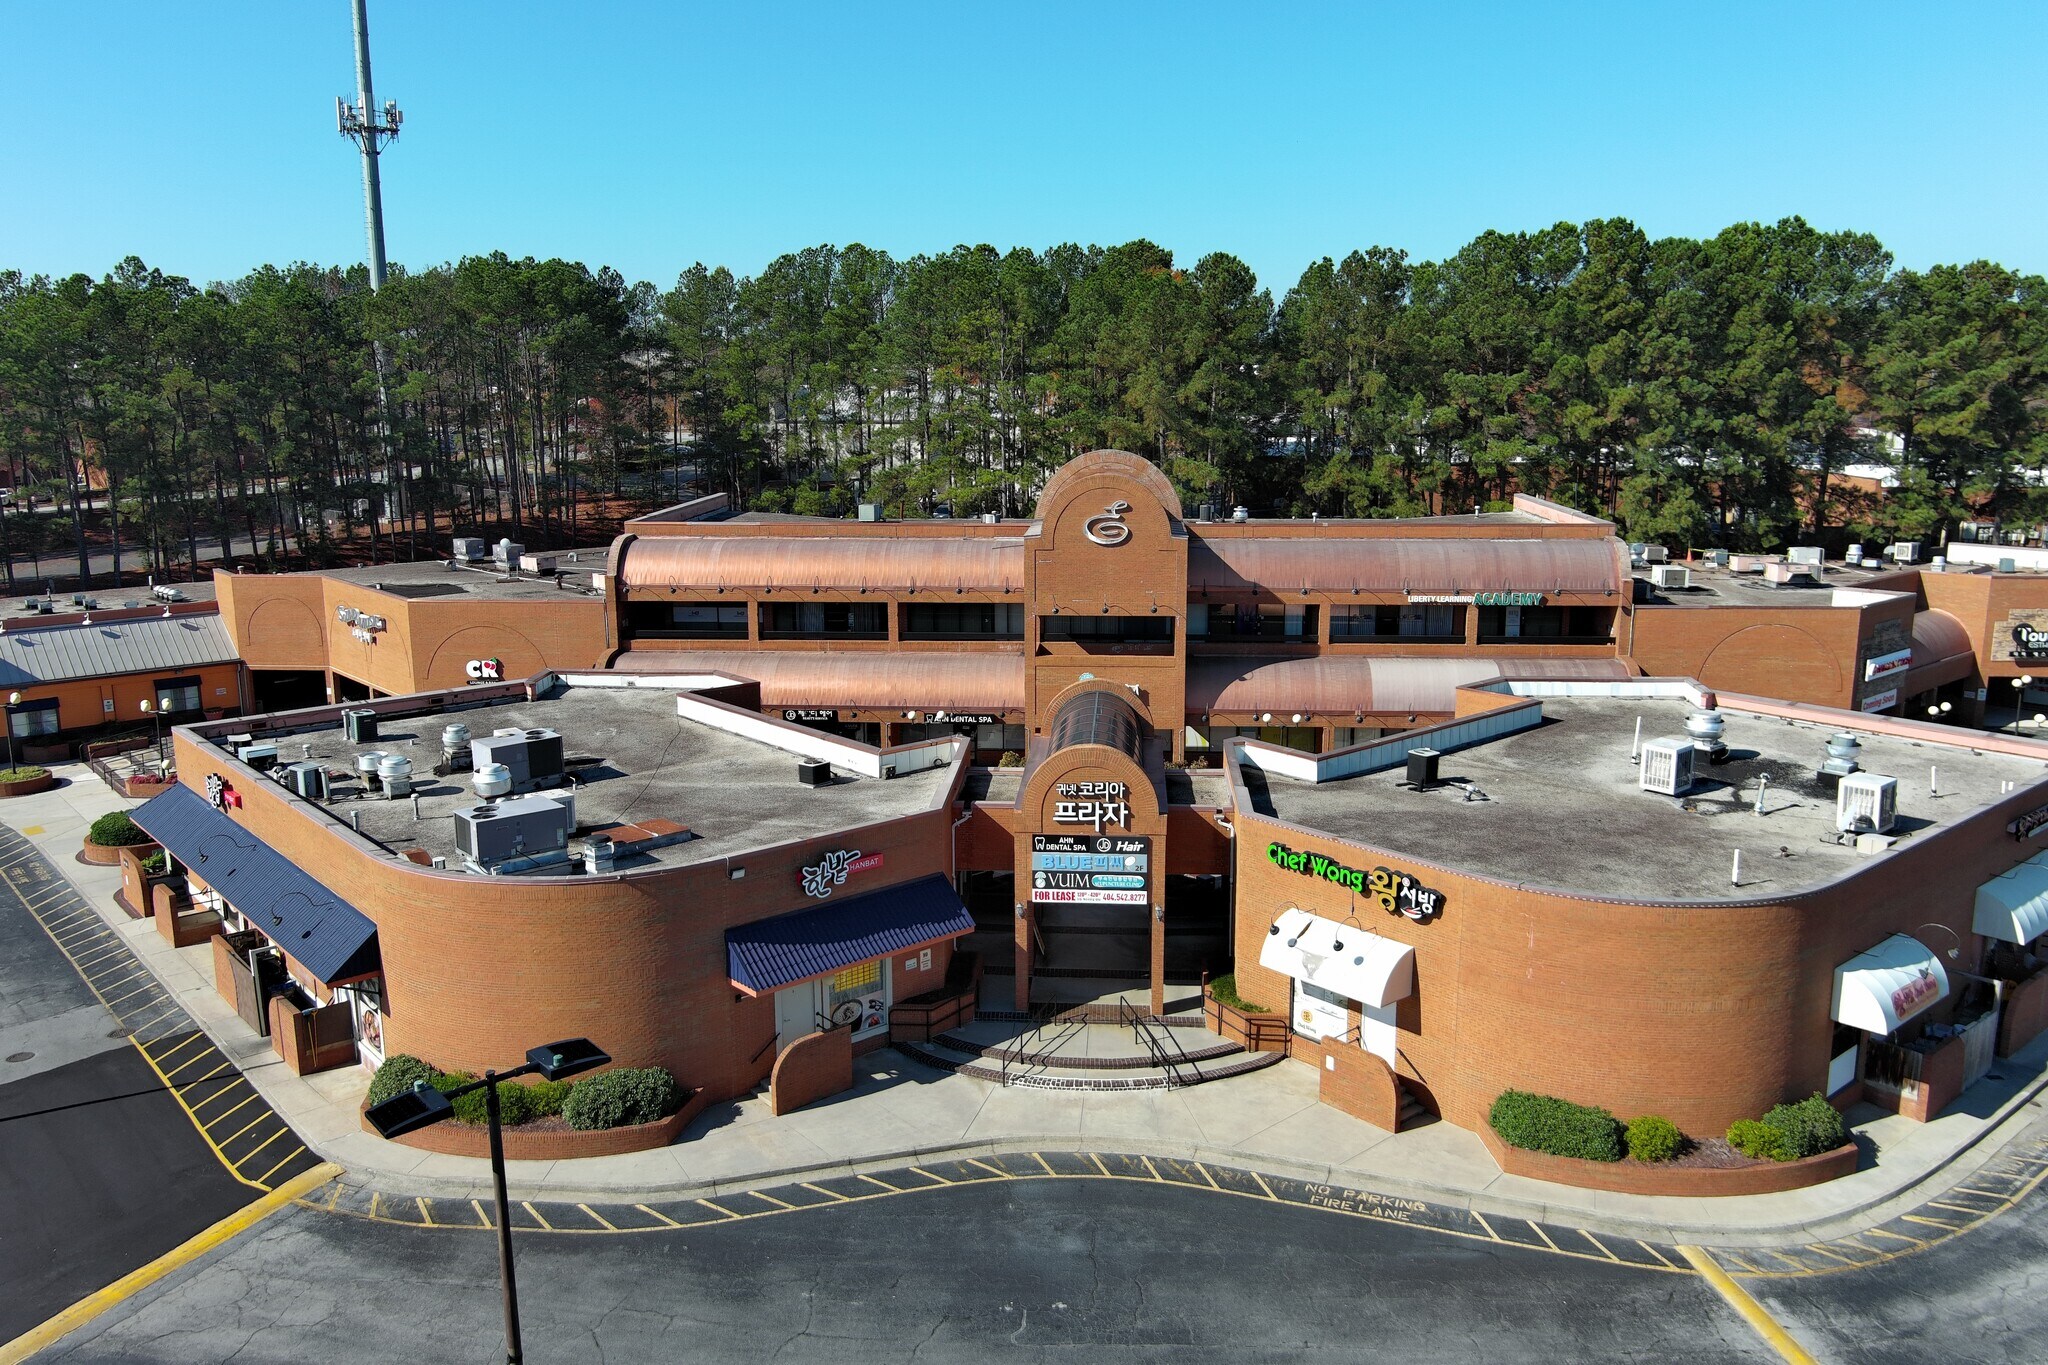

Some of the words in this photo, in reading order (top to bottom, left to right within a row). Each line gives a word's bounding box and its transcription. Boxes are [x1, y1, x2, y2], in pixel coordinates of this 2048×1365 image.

[1472, 592, 1543, 606] ACADEMY
[466, 660, 498, 678] CR
[1056, 784, 1077, 795] 귀넷
[1079, 782, 1125, 802] 코리아
[1053, 802, 1128, 832] 프라자
[1116, 841, 1144, 852] Hair
[849, 858, 879, 871] HANBAT
[1042, 855, 1092, 870] BLUE
[1266, 844, 1307, 871] Chef
[1310, 856, 1364, 893] Wong
[1048, 873, 1090, 888] VUIM
[1035, 891, 1049, 900] FOR
[1052, 891, 1075, 901] LEASE
[1304, 1183, 1330, 1194] NO
[1343, 1190, 1427, 1211] PARKING
[1310, 1195, 1354, 1210] FIRE
[1358, 1204, 1412, 1221] LANE
